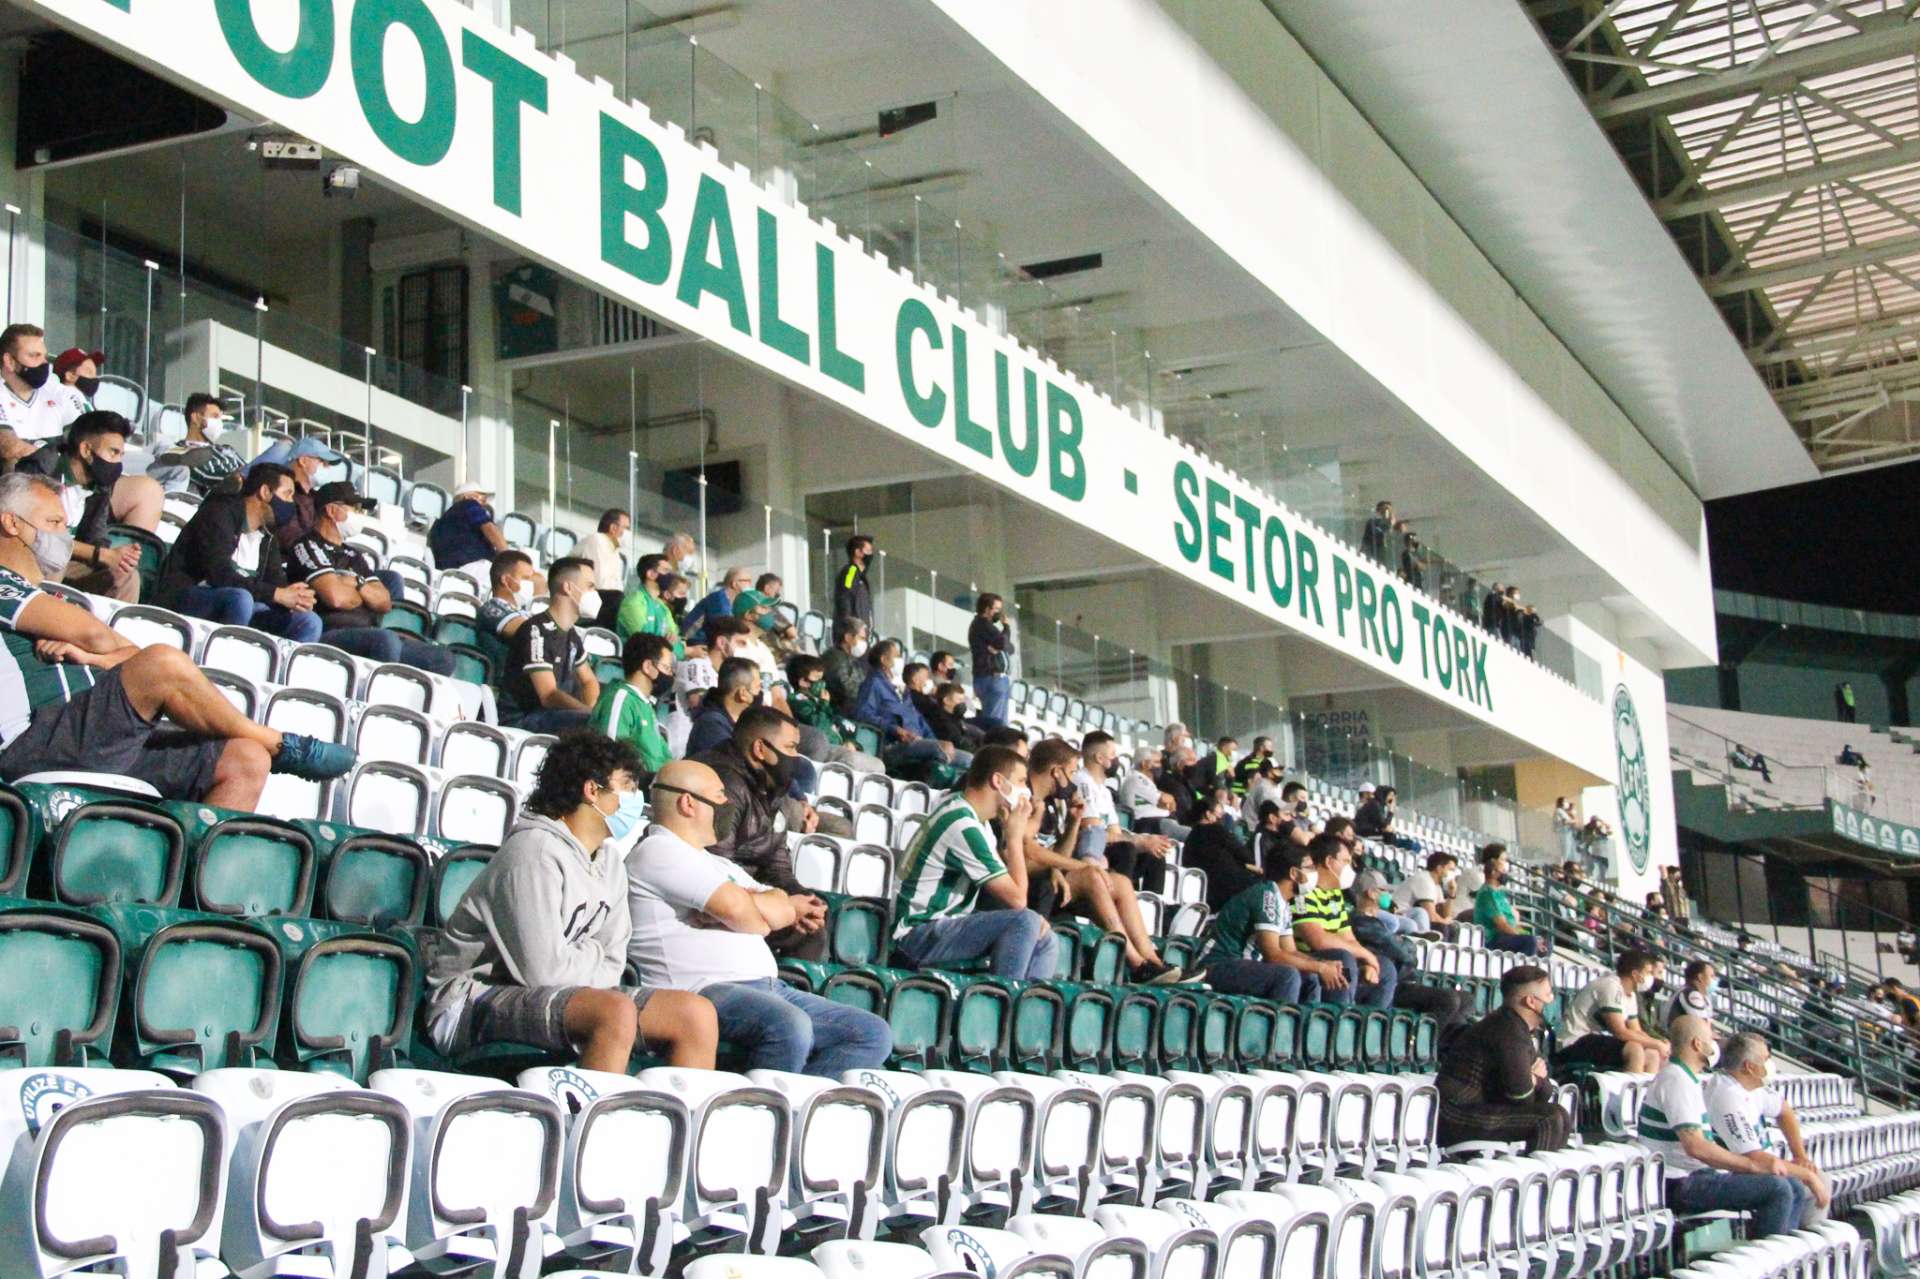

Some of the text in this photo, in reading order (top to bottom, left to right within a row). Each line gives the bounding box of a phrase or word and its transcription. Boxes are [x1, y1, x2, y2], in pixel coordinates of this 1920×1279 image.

[109, 0, 549, 218] OOT
[599, 110, 866, 395] BALL
[895, 298, 1087, 502] CLUB
[1173, 460, 1324, 627] SETOR
[1333, 553, 1404, 665] PRO
[1411, 600, 1494, 712] TORK
[23, 1073, 59, 1120] UTILIZE
